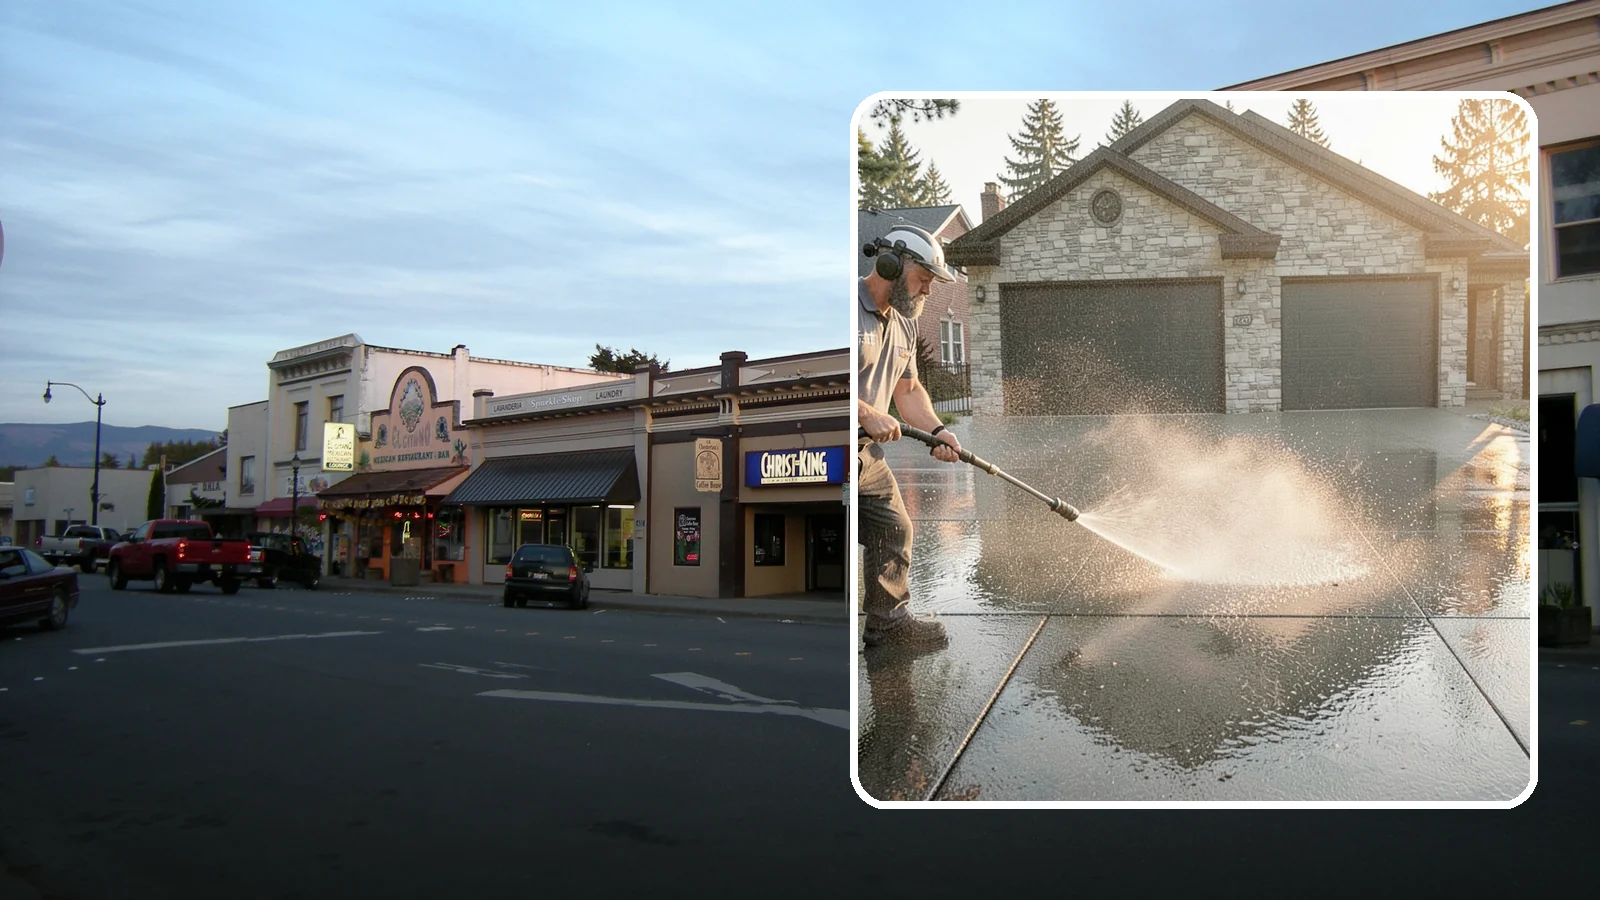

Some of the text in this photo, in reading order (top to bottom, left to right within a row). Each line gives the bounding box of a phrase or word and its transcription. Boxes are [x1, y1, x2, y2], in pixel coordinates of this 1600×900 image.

[562, 395, 582, 404] Shop
[595, 389, 623, 400] LAUNDRY
[493, 402, 522, 412] LAVANDERIA
[438, 450, 450, 459] BAR
[760, 450, 828, 478] CHRIST KING
